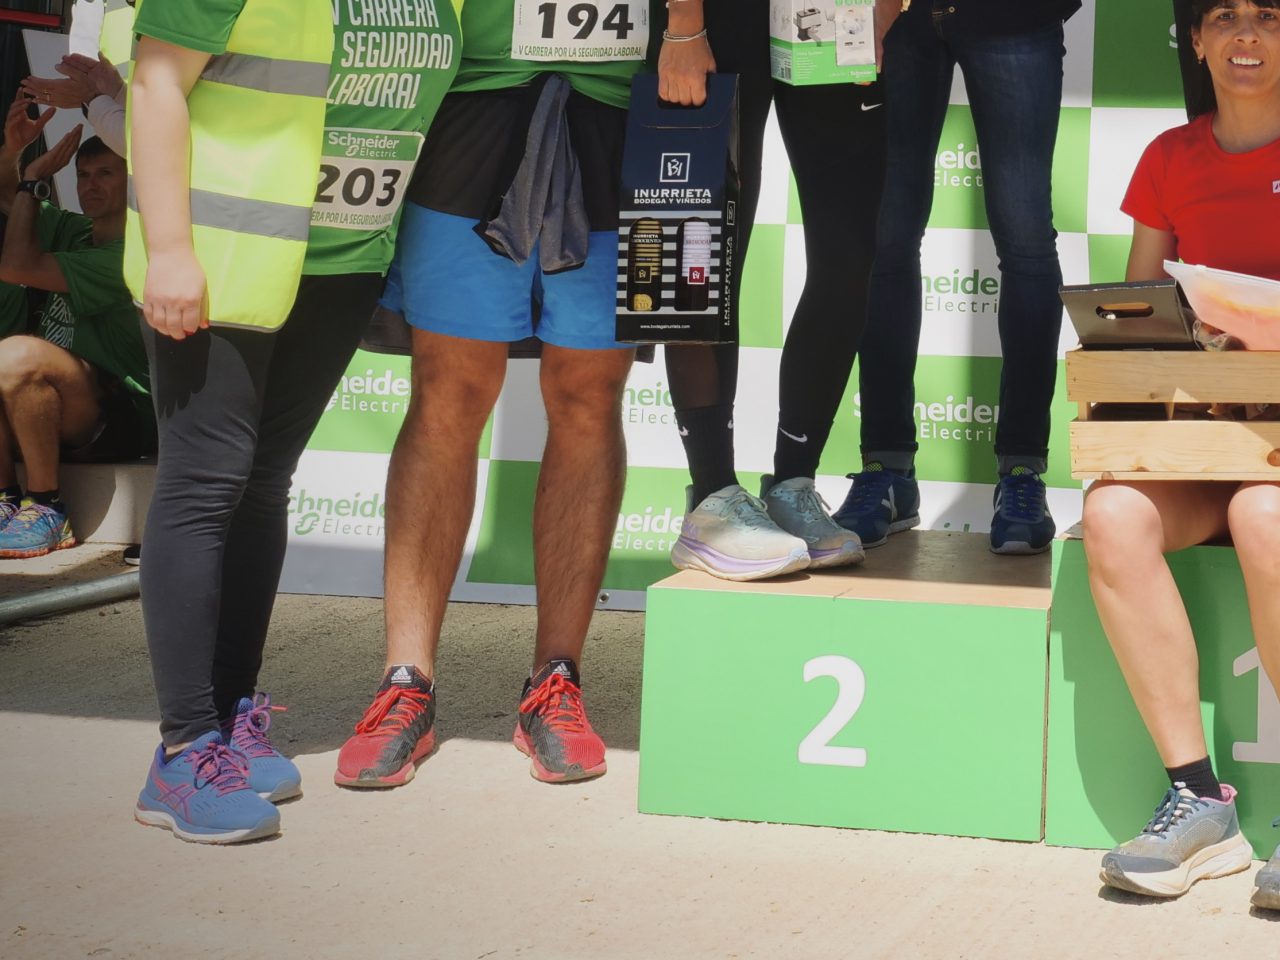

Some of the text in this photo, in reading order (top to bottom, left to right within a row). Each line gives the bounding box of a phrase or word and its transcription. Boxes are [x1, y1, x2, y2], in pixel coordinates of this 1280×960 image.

[537, 1, 634, 40] 194
[340, 31, 454, 70] SEGURIDAD
[524, 45, 553, 57] CARRERA
[555, 47, 568, 57] POR
[568, 47, 577, 57] LA
[325, 72, 422, 110] LABORAL
[328, 130, 400, 150] Schneider
[360, 147, 398, 159] Electric
[313, 163, 402, 208] 203
[633, 188, 712, 198] INURRIETA
[924, 295, 998, 314] Electri
[341, 395, 408, 414] Electri
[919, 422, 993, 442] Electri
[797, 653, 868, 768] 2
